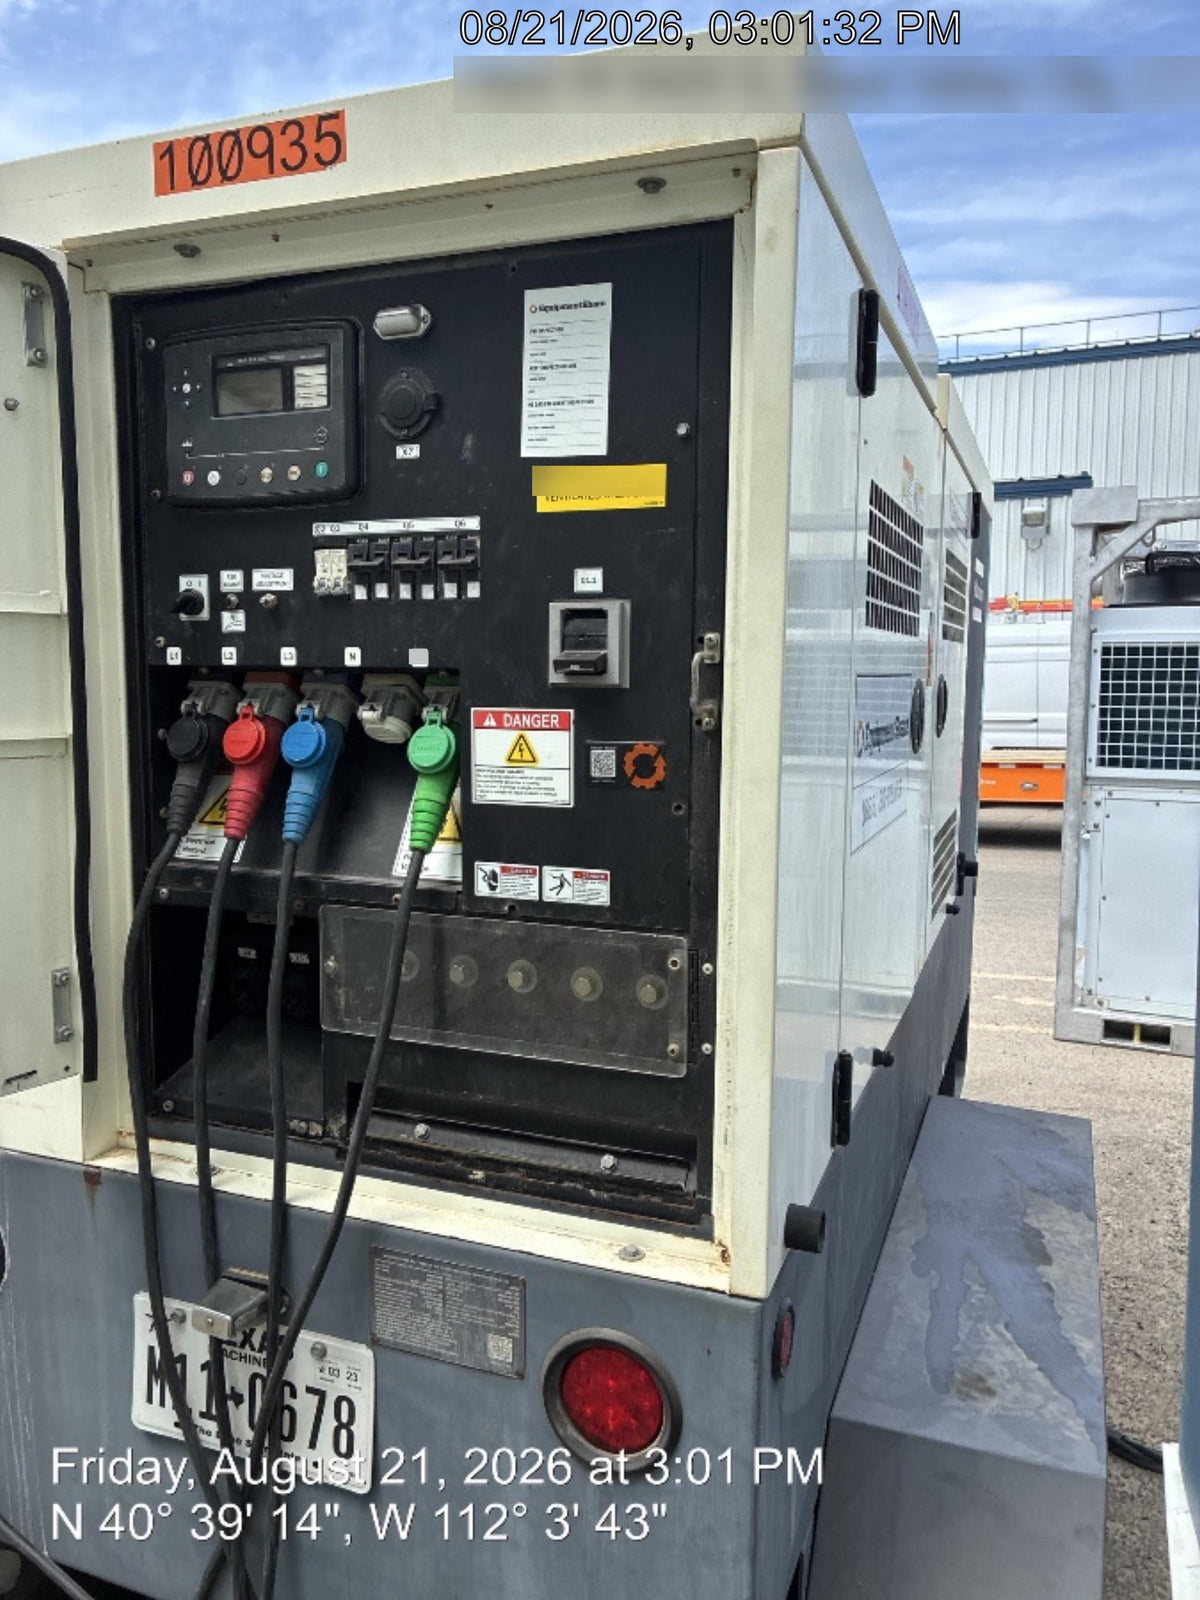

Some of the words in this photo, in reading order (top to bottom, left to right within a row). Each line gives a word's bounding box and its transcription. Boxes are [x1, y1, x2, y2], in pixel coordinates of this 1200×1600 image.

[159, 111, 342, 191] 100935
[223, 651, 234, 660] L2
[503, 713, 559, 728] DANGER
[346, 1370, 358, 1382] 23
